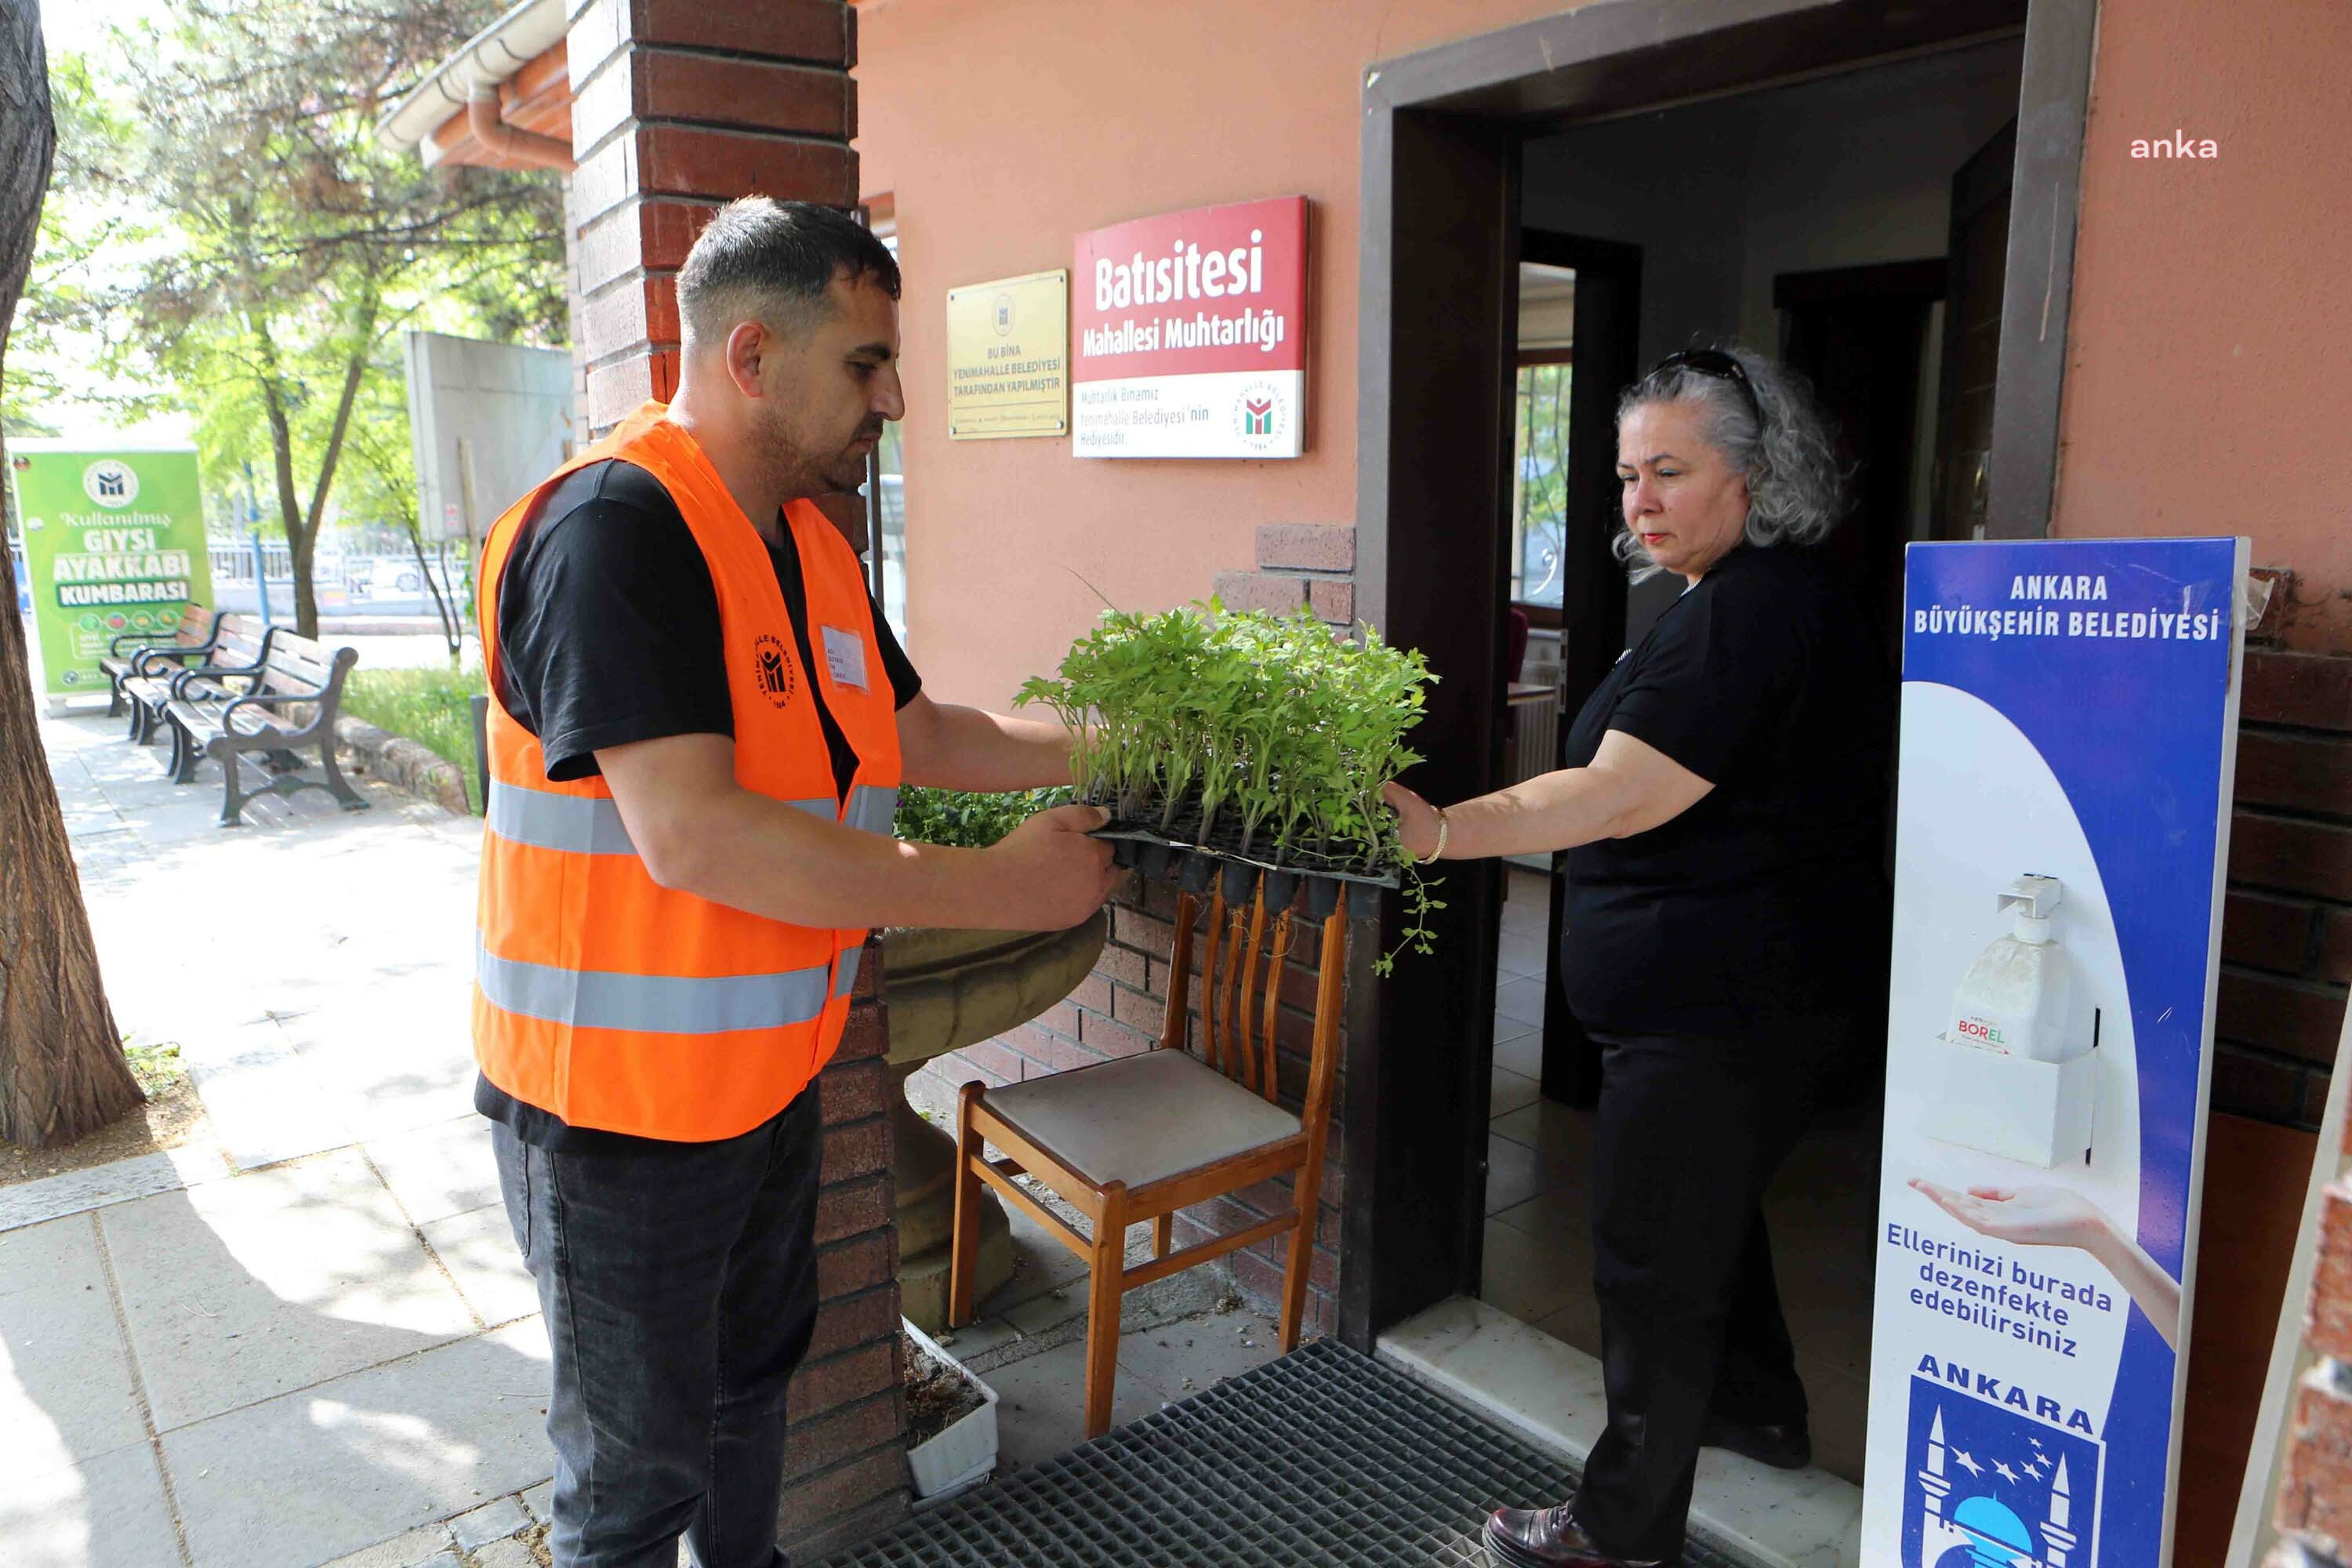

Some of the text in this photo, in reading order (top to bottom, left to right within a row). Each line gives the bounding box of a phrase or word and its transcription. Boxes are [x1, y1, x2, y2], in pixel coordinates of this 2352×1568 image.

[1095, 228, 1262, 311] Batısitesi
[1083, 307, 1284, 357] Mahallesi Muhtarlığı
[986, 344, 1021, 359] BU BİNA
[1011, 356, 1060, 374] BELEDİYESİ
[953, 377, 1060, 396] TARAFINDAN YAPILMIŞTIR
[54, 553, 191, 581] AYAKKABI
[60, 582, 188, 605] KUMBARASI
[2010, 575, 2107, 601] ANKARA
[1914, 605, 2220, 641] BÜYÜKŞEHİR BELEDİYESİ
[1958, 1020, 2005, 1044] BOREL
[1886, 1223, 2111, 1312] Ellerinizi burada
[1919, 1261, 2069, 1326] dezenfekte
[1909, 1287, 2076, 1358] edebilirsiniz
[1918, 1354, 2093, 1436] ANKARA
